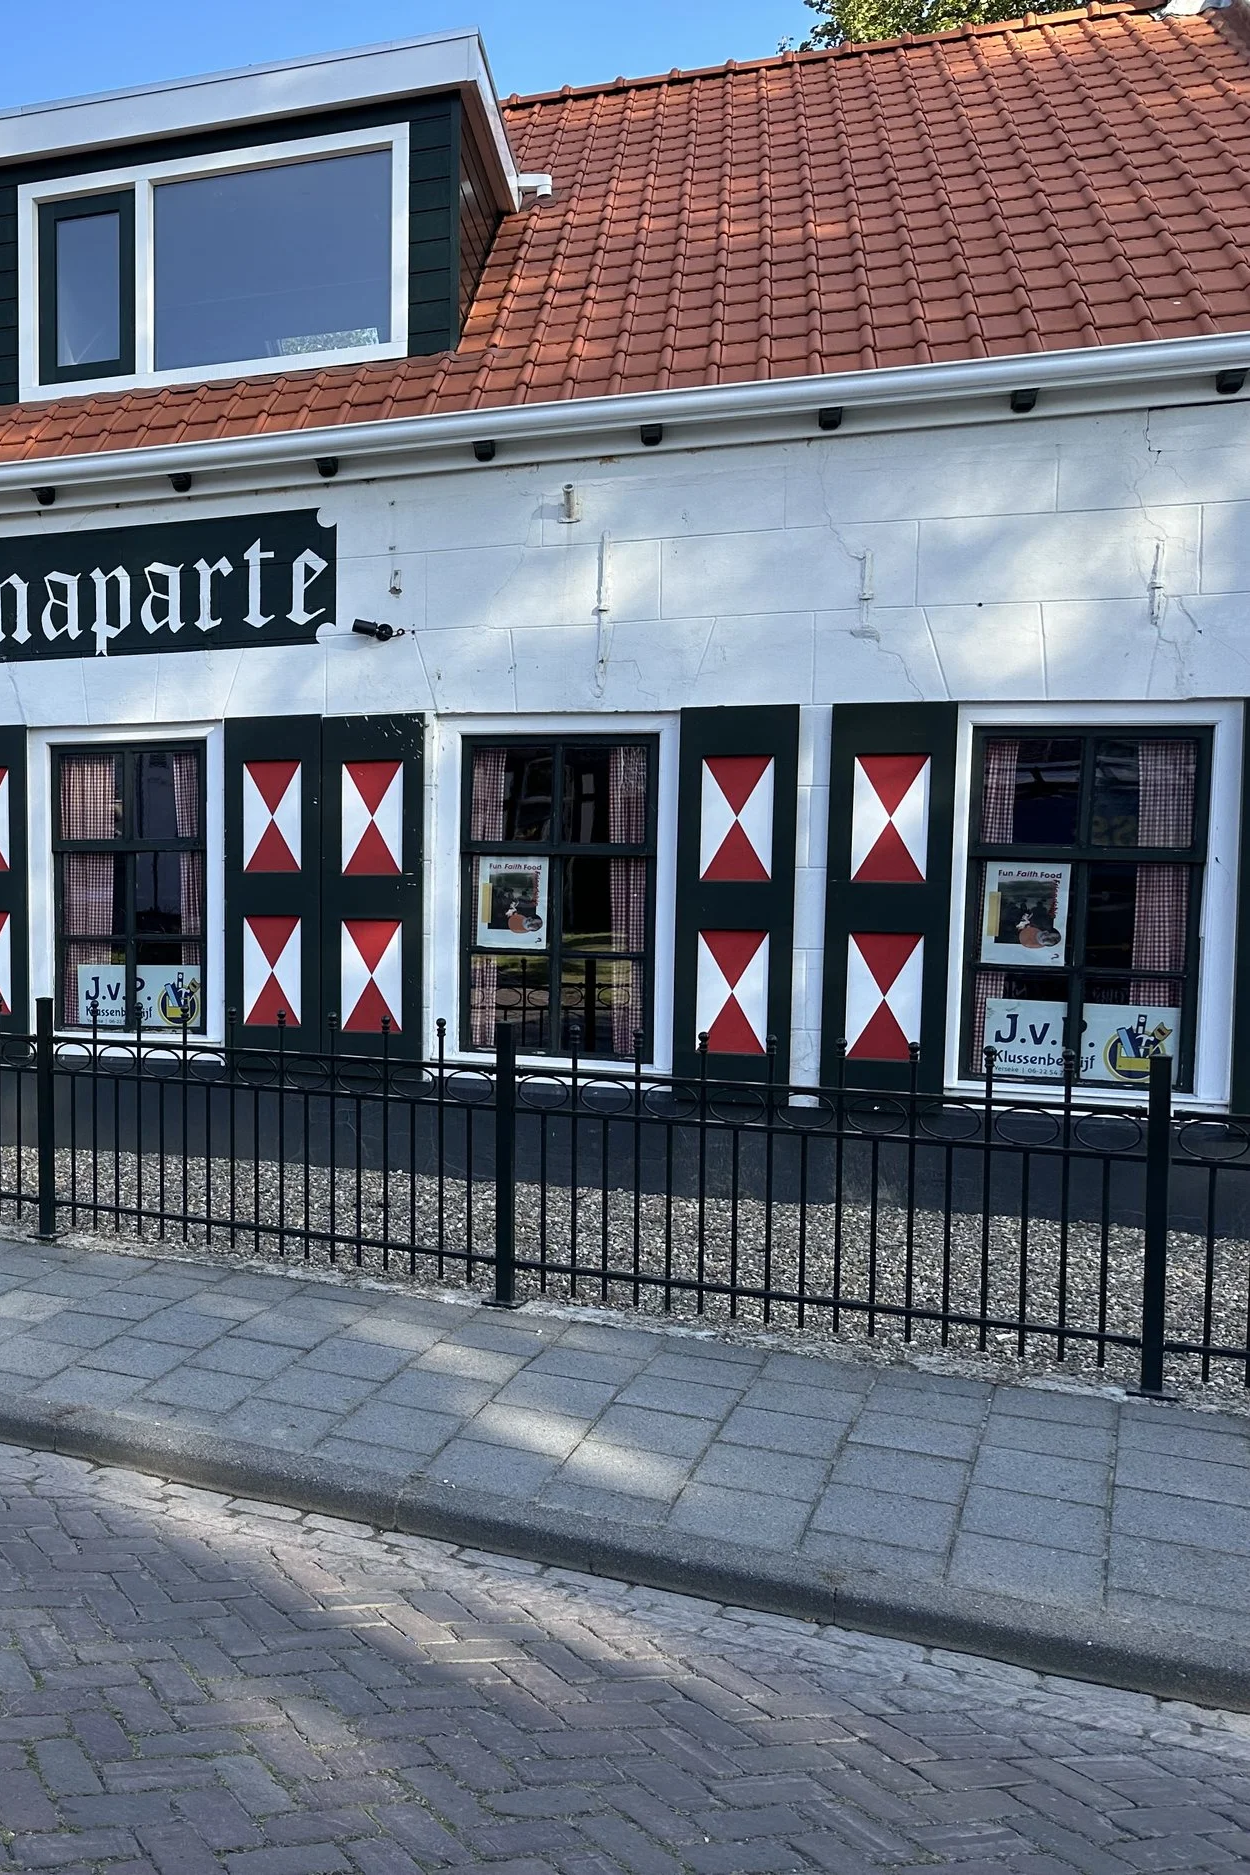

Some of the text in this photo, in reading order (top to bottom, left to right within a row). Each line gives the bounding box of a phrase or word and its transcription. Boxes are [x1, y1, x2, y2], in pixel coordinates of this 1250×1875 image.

[998, 869, 1062, 879] Fun Faith Food
[994, 1049, 1096, 1073] Klussenbeijf
